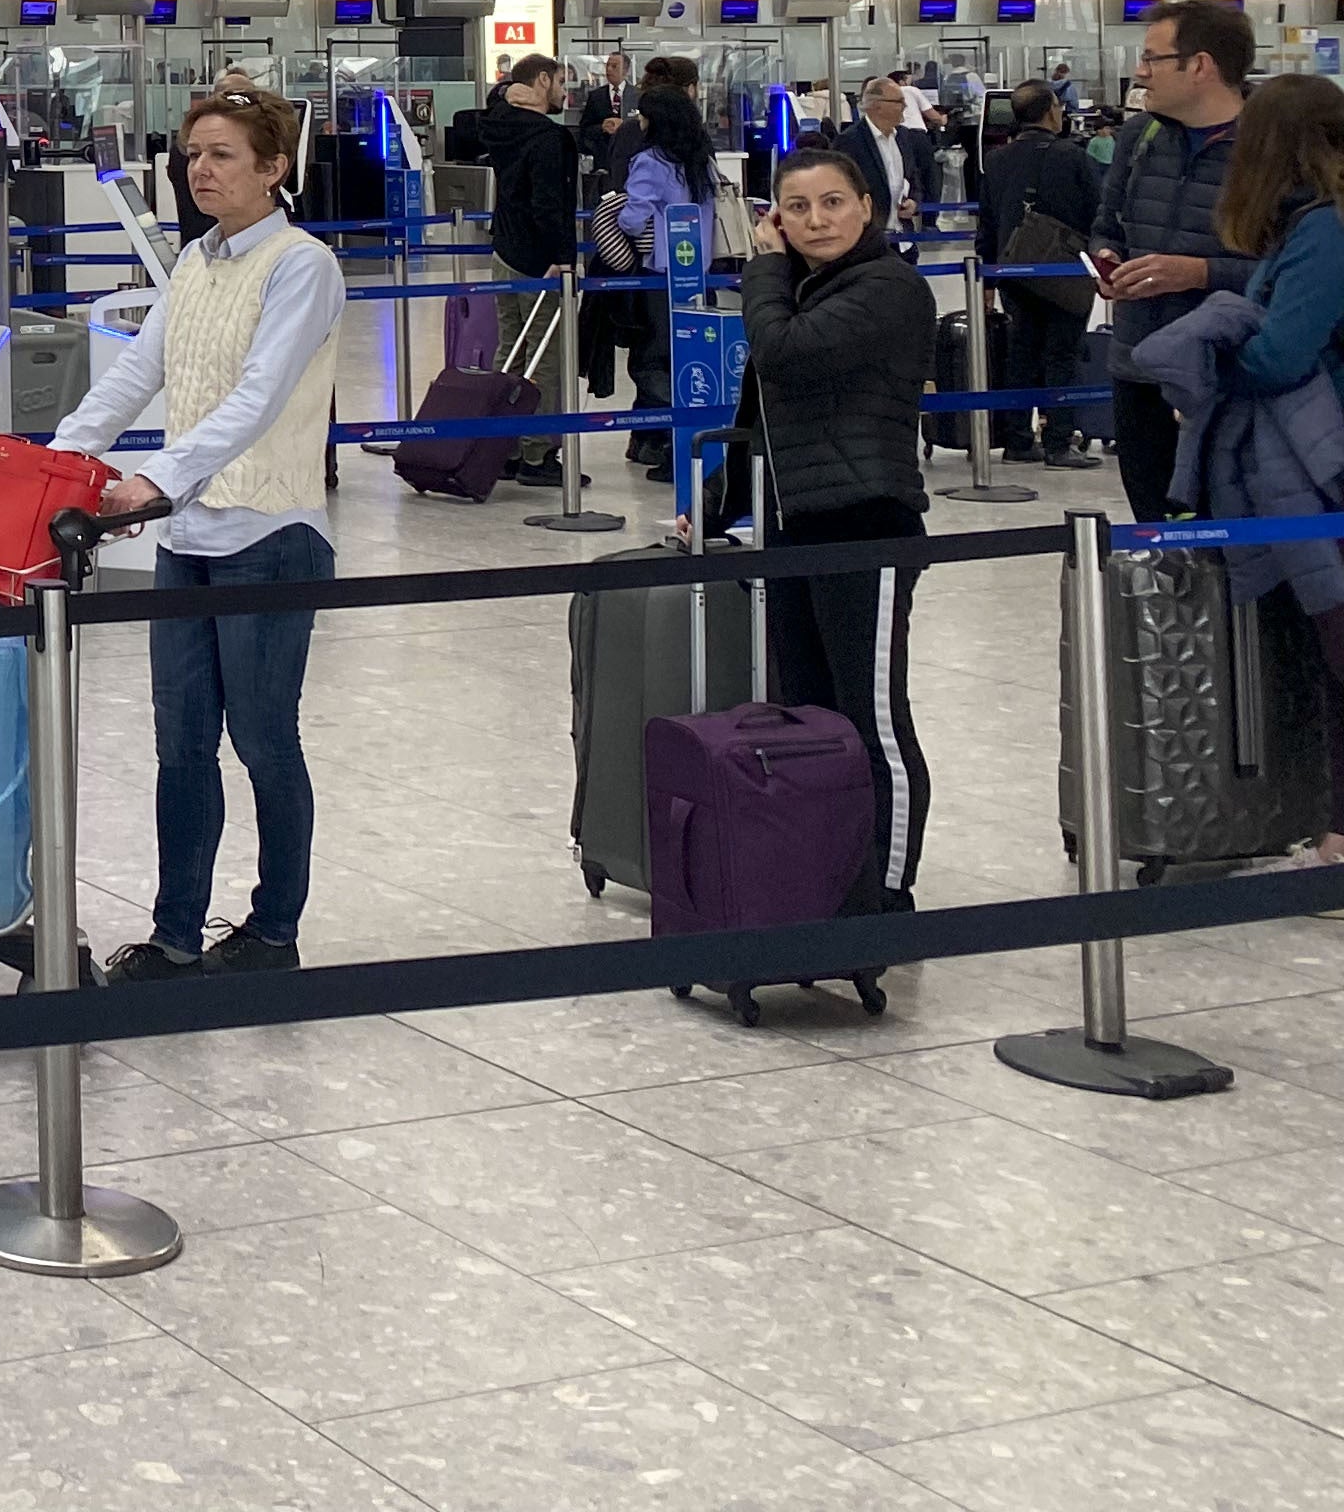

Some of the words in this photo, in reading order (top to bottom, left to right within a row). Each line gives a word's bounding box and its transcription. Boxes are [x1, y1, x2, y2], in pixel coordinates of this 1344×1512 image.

[504, 26, 526, 41] A1
[1164, 531, 1195, 540] BRITISH
[1196, 529, 1229, 539] AIRWAYS
